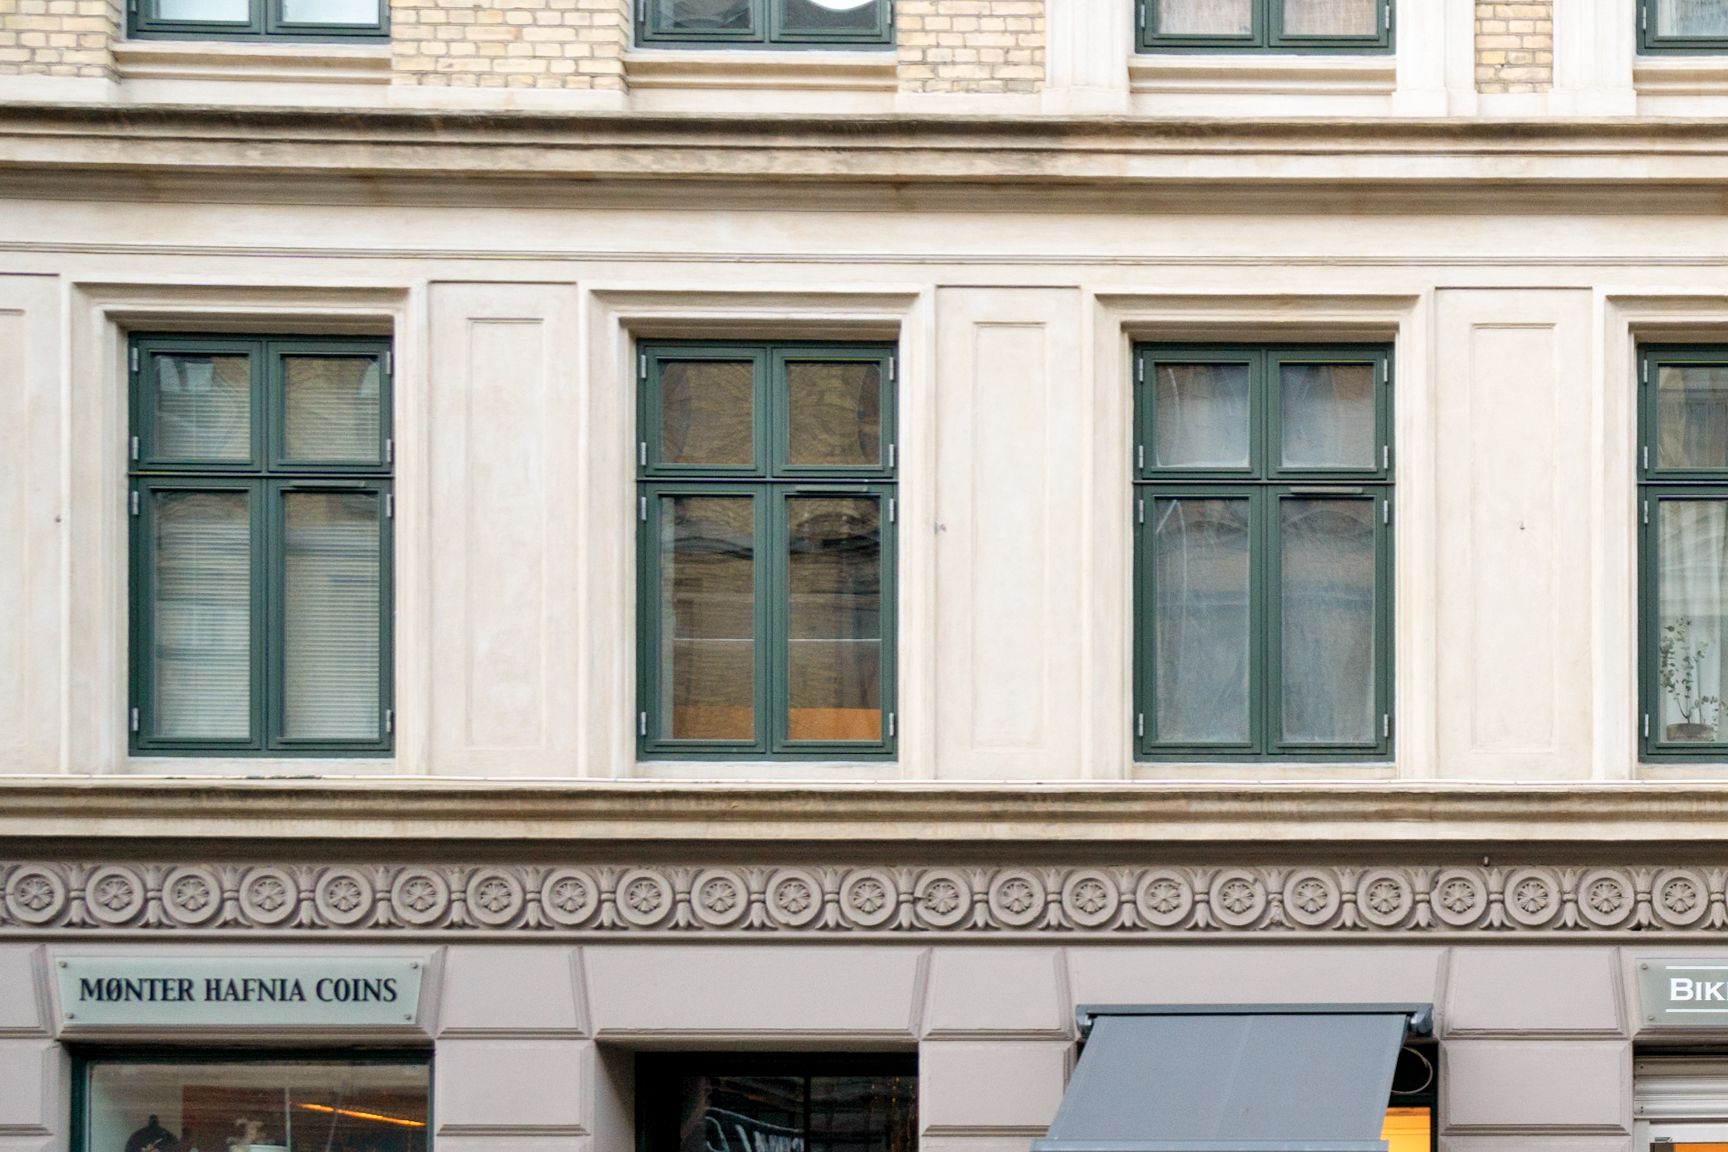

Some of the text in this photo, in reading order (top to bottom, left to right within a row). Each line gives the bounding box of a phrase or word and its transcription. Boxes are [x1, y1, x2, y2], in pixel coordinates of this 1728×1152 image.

[79, 977, 398, 1001] MØNTER HAFNIA COINS
